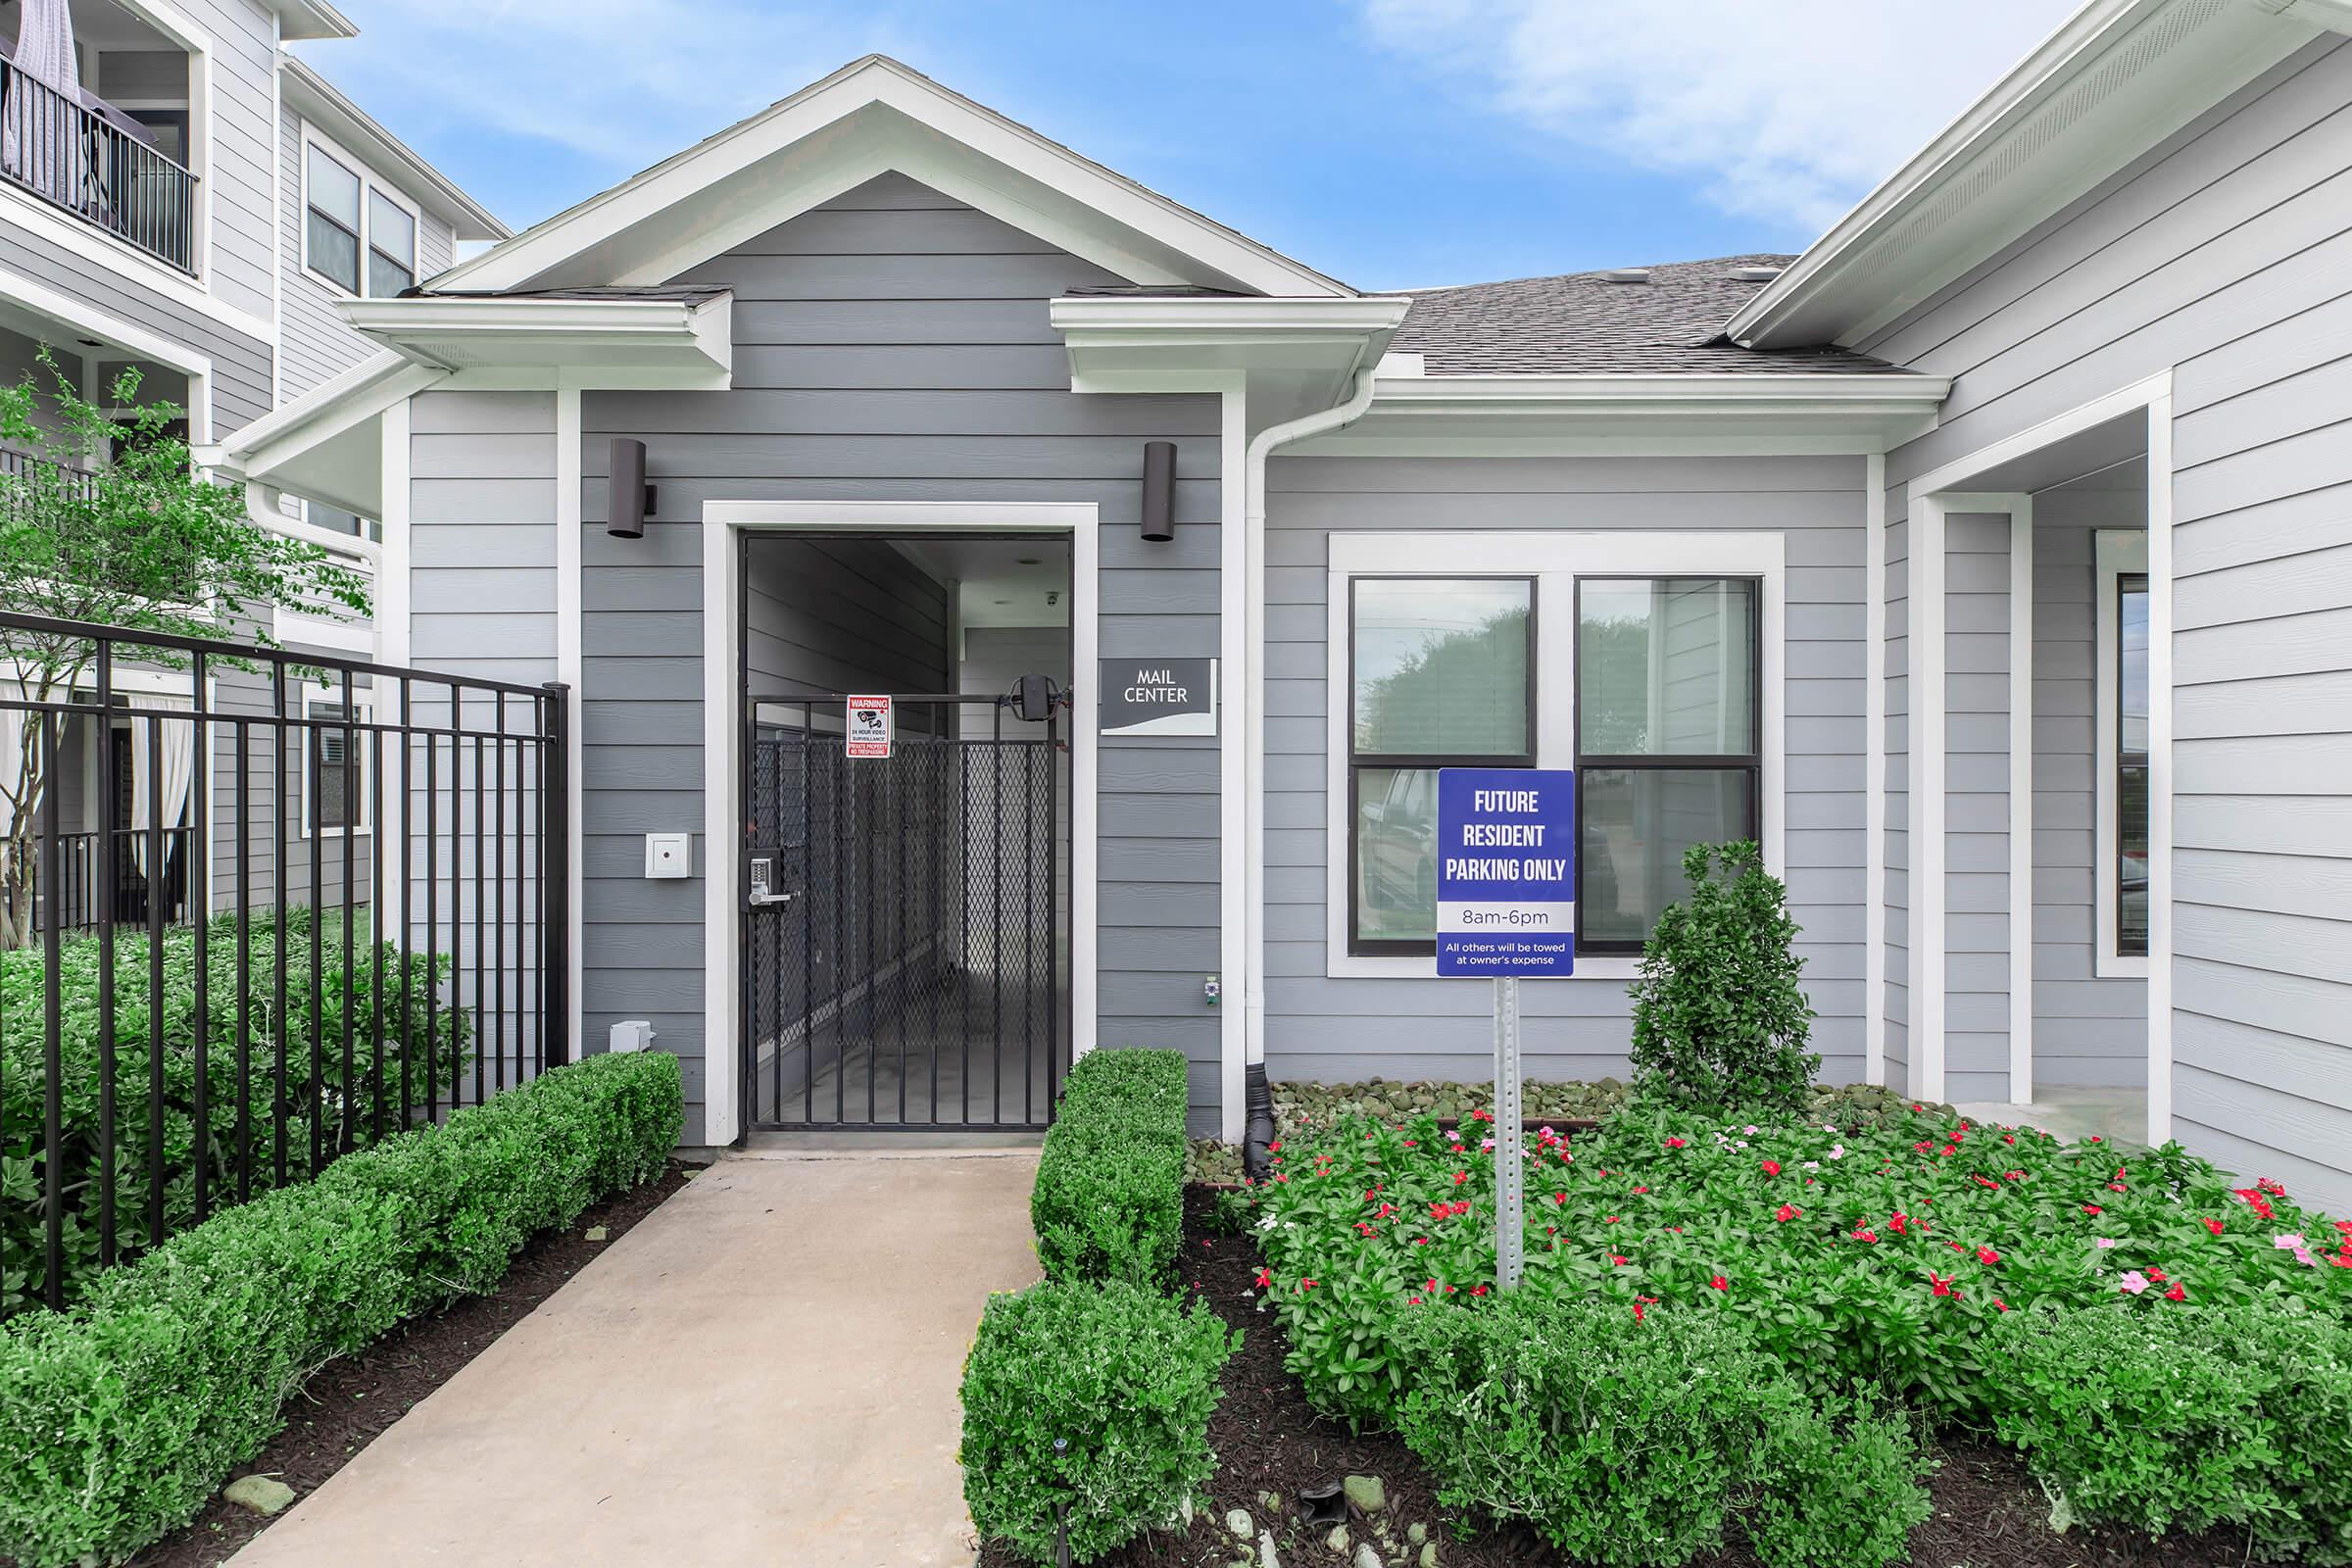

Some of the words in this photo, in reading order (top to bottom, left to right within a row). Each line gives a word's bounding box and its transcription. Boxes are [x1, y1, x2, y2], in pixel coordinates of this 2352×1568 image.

[1137, 669, 1176, 684] MAIL
[1124, 687, 1188, 703] CENTER
[851, 699, 888, 709] WARNING
[1474, 790, 1539, 812] FUTURE
[1463, 824, 1545, 847] RESIDENT
[1446, 858, 1520, 881] PARKING
[1523, 858, 1566, 881] ONLY
[1462, 909, 1548, 927] 8am-6pm
[1446, 943, 1459, 953] All
[1461, 943, 1495, 953] others
[1497, 943, 1515, 953] will
[1517, 943, 1531, 953] be
[1533, 943, 1566, 953] towed
[1456, 956, 1467, 965] at
[1469, 956, 1509, 965] owner's
[1512, 957, 1554, 966] expense
